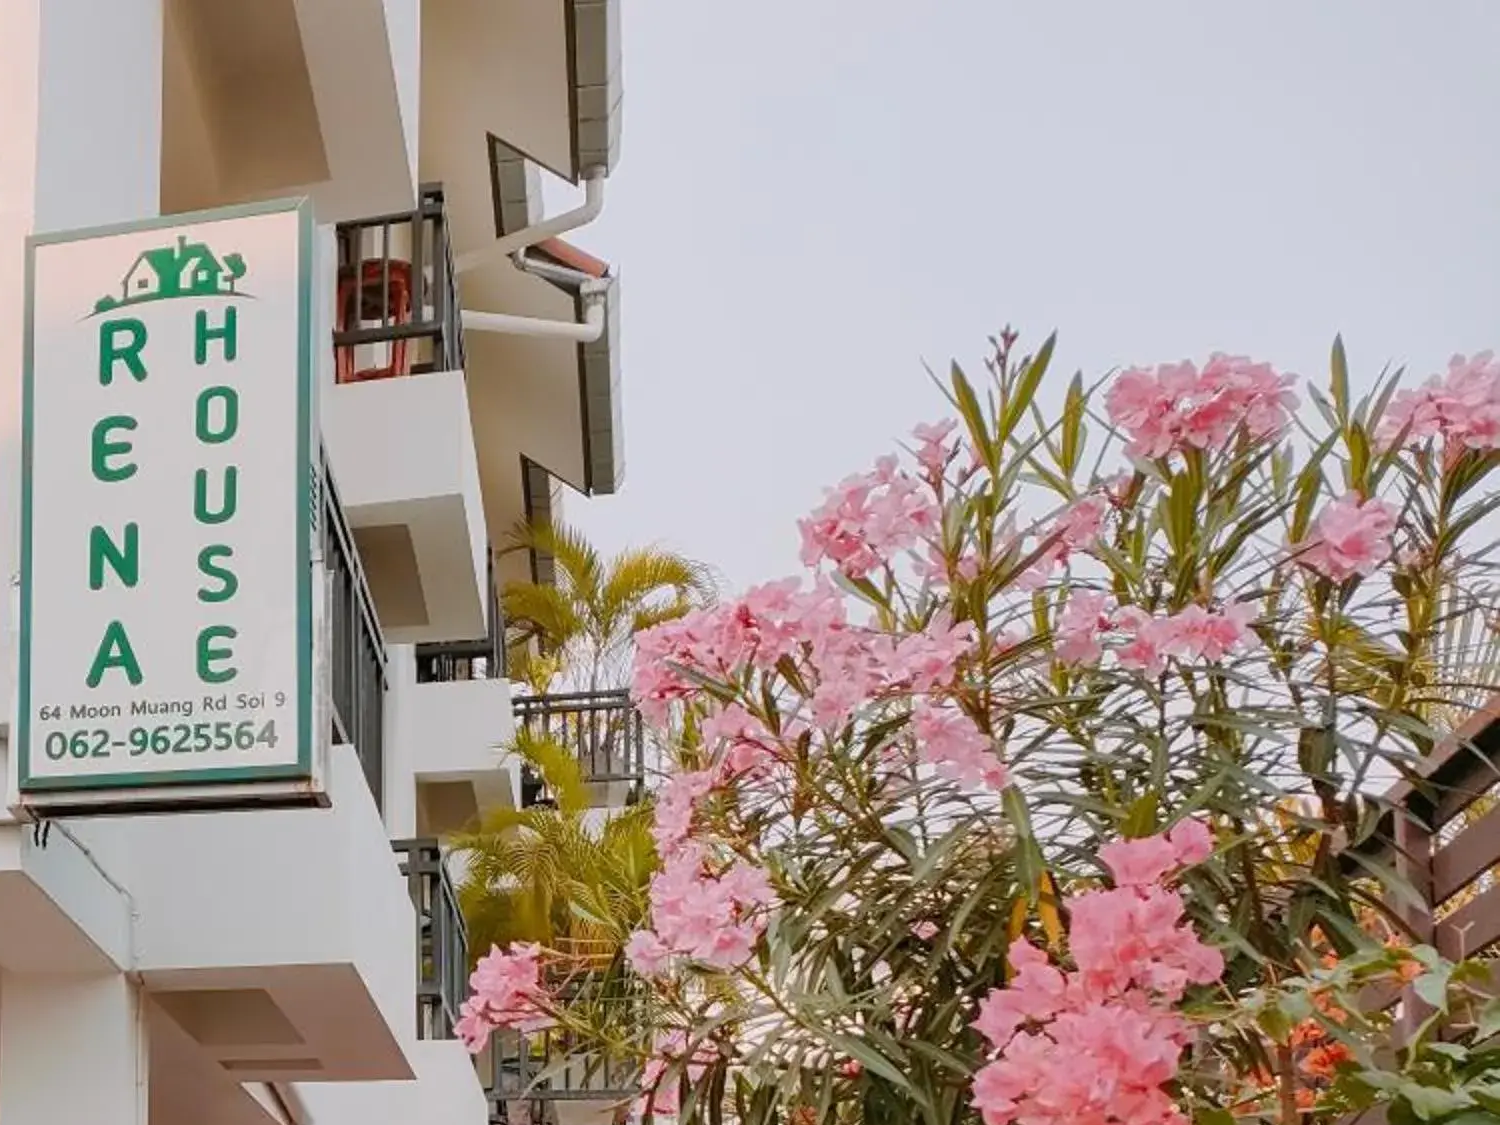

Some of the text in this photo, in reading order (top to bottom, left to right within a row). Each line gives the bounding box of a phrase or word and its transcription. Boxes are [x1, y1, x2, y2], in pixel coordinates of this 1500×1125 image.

[84, 316, 149, 689] RENA
[193, 305, 239, 685] HOUSE
[39, 691, 286, 721] 64 Moon Muang Rd Soi 9
[44, 718, 279, 761] 062-9625564
